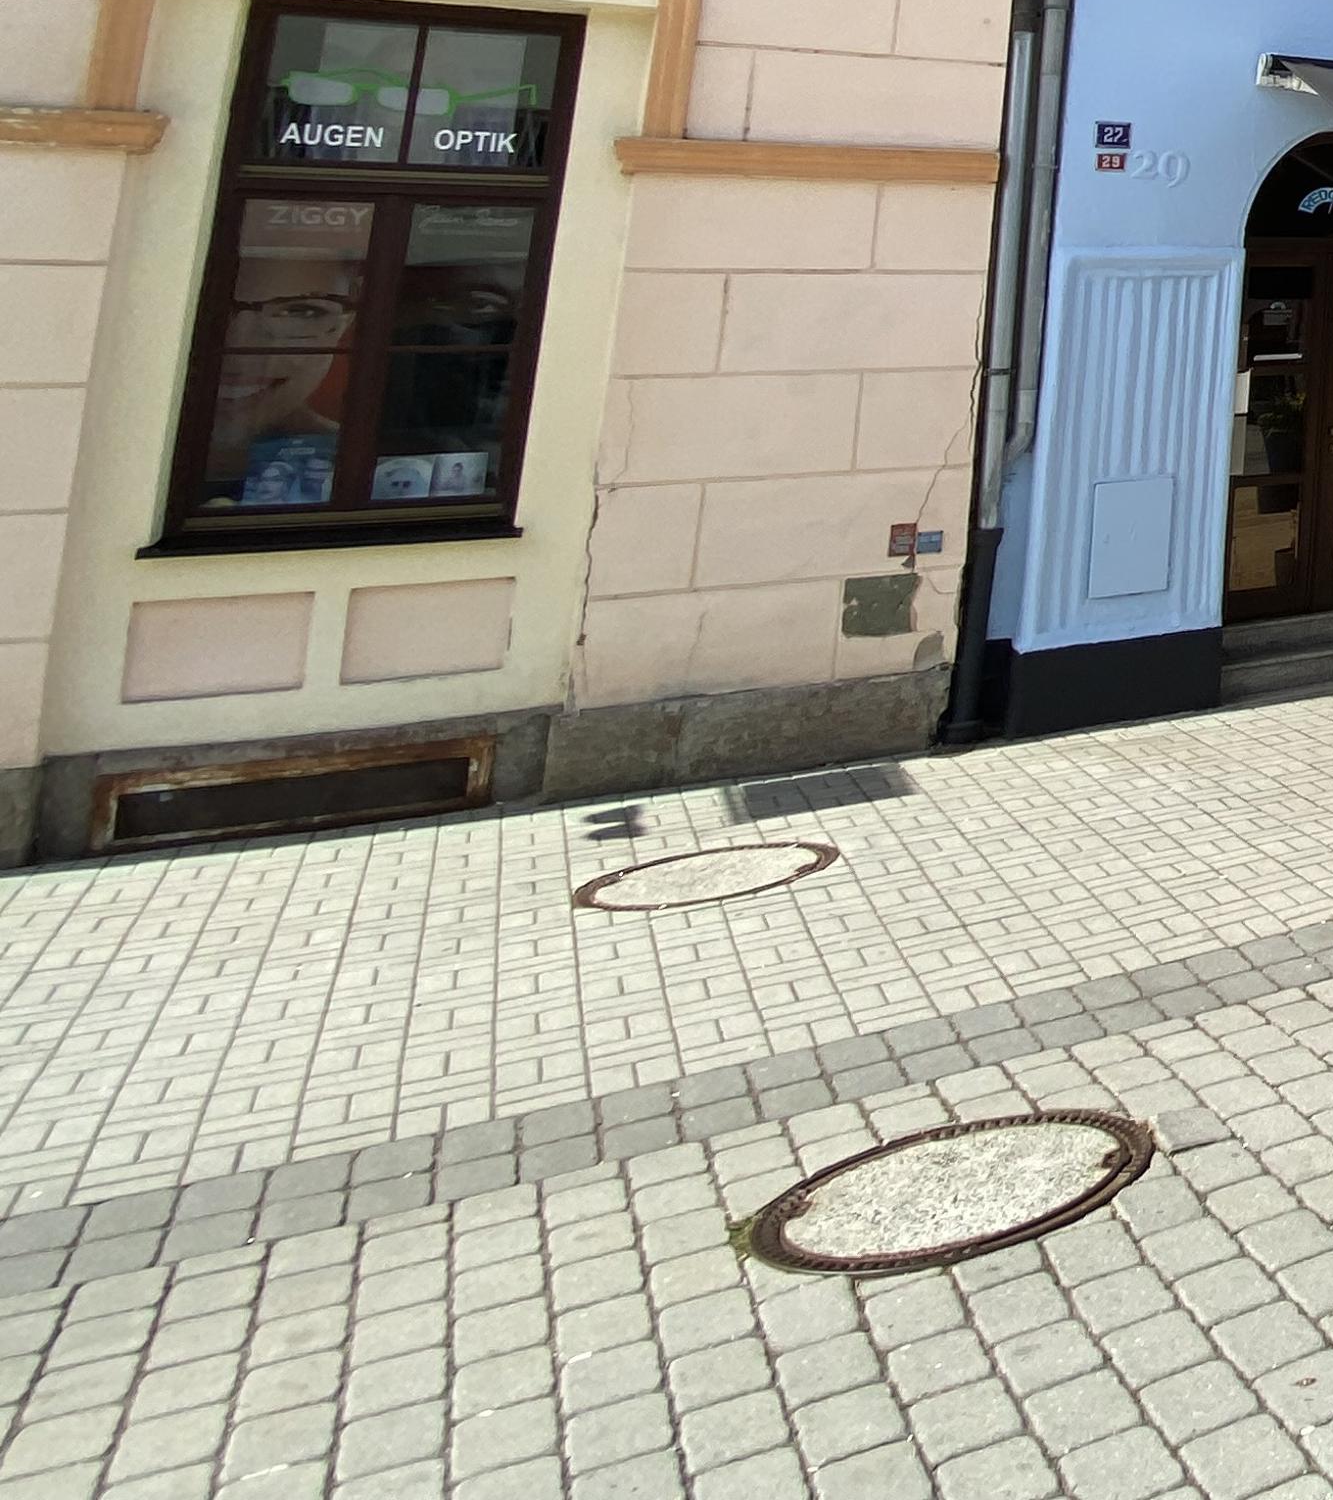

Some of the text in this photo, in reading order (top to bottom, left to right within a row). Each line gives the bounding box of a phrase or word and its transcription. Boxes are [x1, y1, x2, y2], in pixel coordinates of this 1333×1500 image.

[279, 123, 518, 154] AUGEN OPTIK
[1103, 126, 1124, 143] 27
[1102, 155, 1121, 168] 29
[1130, 150, 1191, 189] 29
[267, 205, 370, 226] ZIGGY
